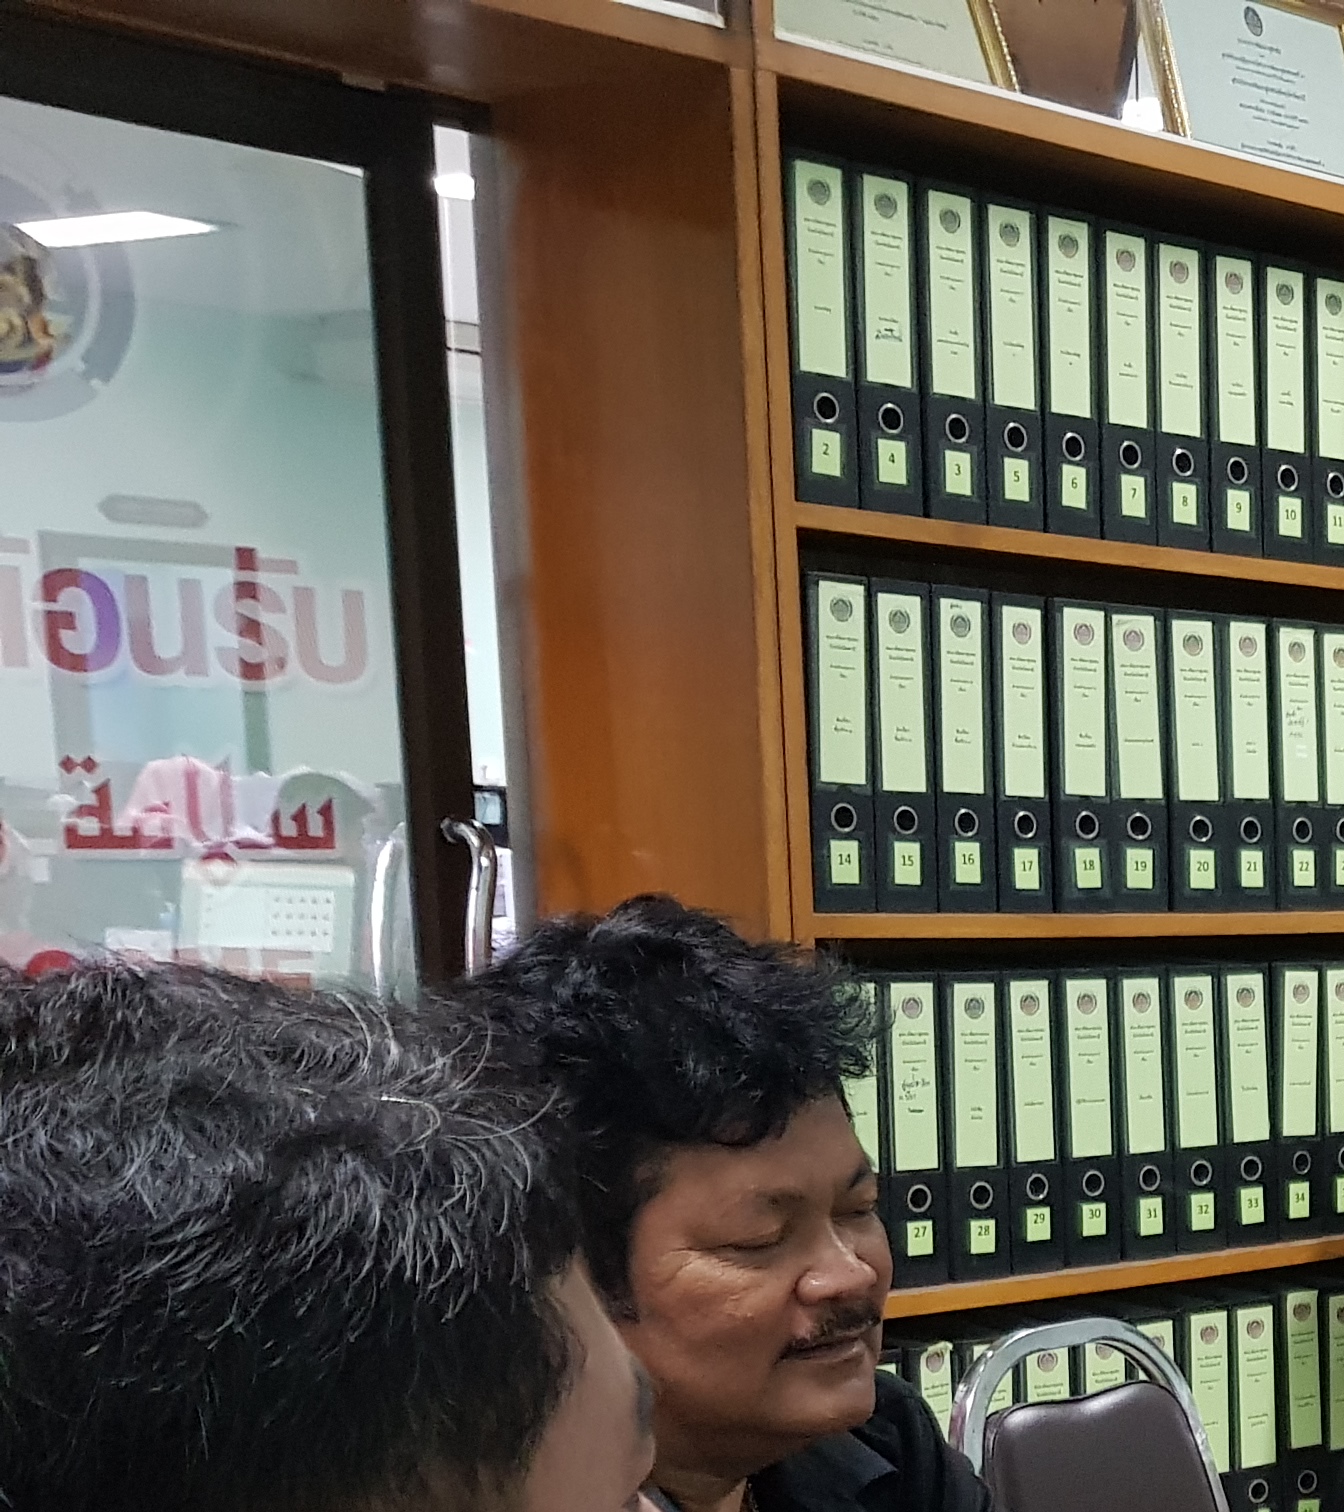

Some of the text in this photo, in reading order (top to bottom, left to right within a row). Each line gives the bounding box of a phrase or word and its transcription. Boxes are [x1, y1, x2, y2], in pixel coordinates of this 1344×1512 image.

[822, 442, 830, 456] 2
[888, 452, 896, 464] 4
[954, 463, 962, 477] 3
[1013, 470, 1020, 483] 5
[1071, 476, 1078, 490] 6
[1131, 487, 1137, 499] 7
[1181, 495, 1189, 507] 8
[1235, 501, 1242, 514] 9
[1285, 508, 1297, 521] 10
[1333, 515, 1343, 528] 11
[838, 853, 852, 866] 14
[901, 854, 914, 867] 15
[962, 853, 975, 865] 16
[1082, 859, 1095, 871] 18
[1021, 860, 1034, 872] 17
[1134, 860, 1147, 872] 19
[1196, 860, 1210, 873] 20
[1246, 860, 1258, 872] 21
[1298, 860, 1310, 872] 22
[1247, 1197, 1259, 1209] 33
[1294, 1192, 1306, 1204] 34
[1087, 1207, 1102, 1220] 30
[1146, 1207, 1158, 1219] 31
[1197, 1203, 1210, 1215] 32
[1033, 1212, 1046, 1225] 29
[913, 1225, 927, 1238] 27
[977, 1224, 990, 1237] 28
